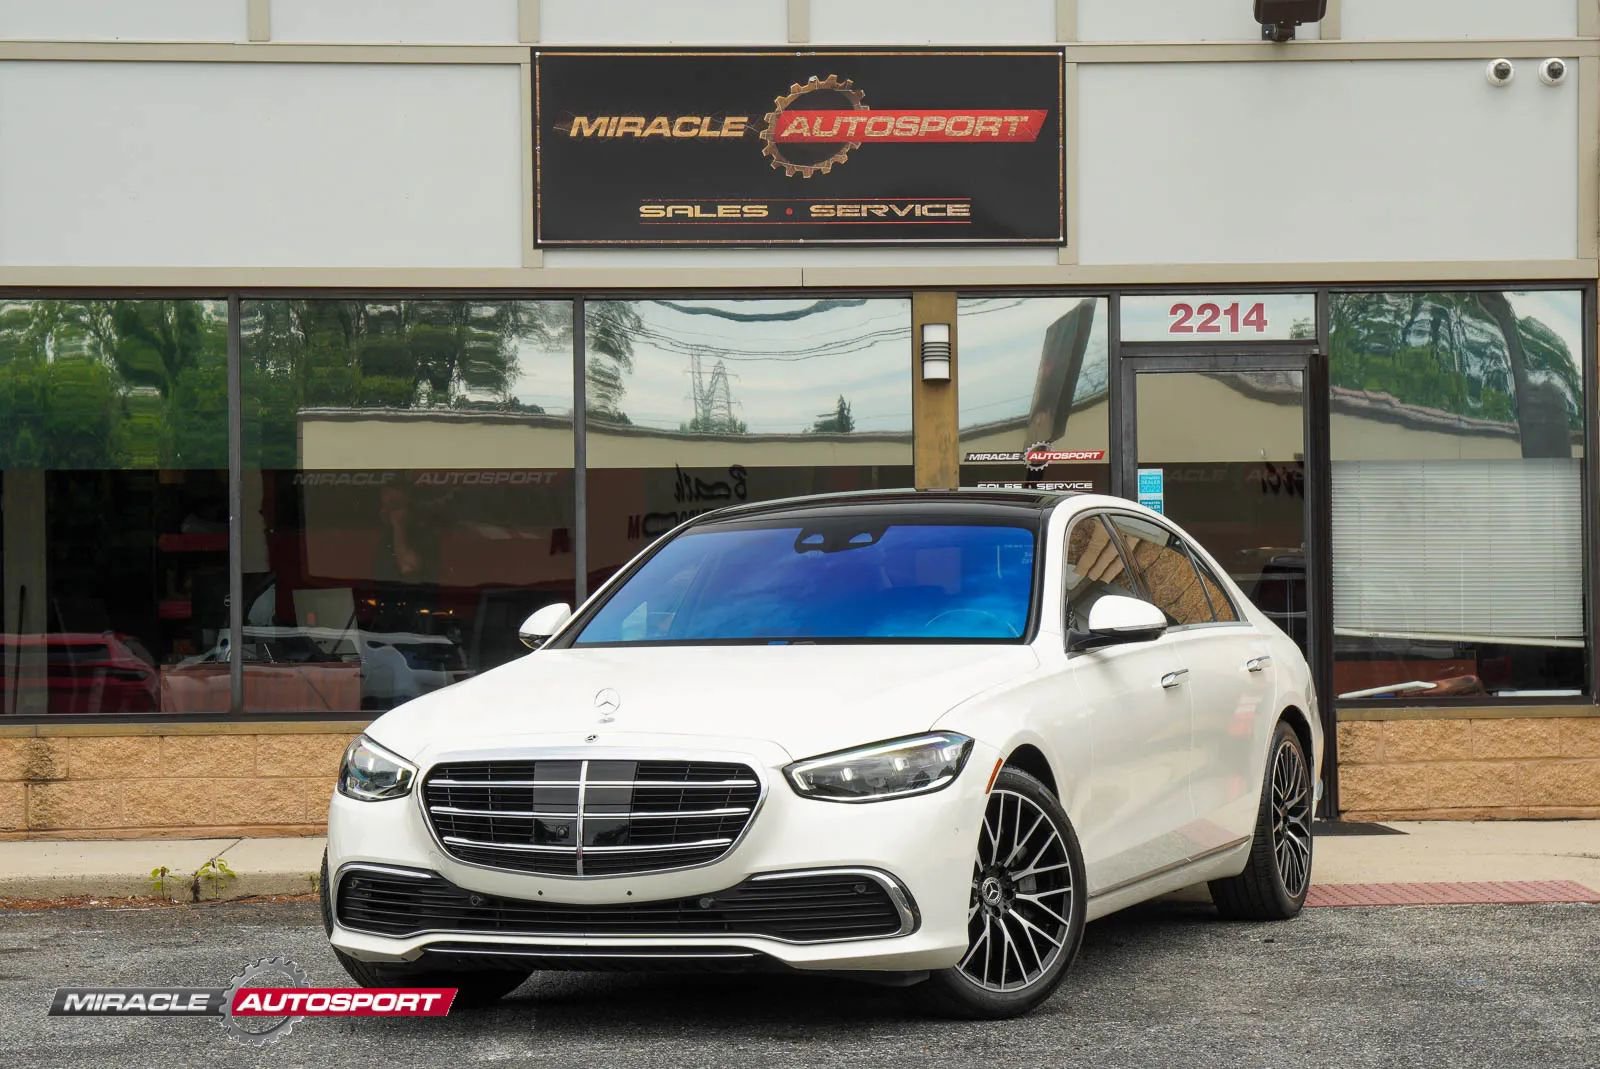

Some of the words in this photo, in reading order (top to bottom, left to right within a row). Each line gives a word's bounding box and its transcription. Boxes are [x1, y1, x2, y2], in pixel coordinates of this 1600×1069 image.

[569, 116, 749, 137] MIRACLE
[780, 115, 1030, 137] AUTOSPORT
[639, 204, 769, 218] SALES
[810, 203, 971, 218] SERVICE
[1168, 302, 1268, 334] 2214
[969, 453, 1020, 461] MIRACLE
[1029, 452, 1100, 460] AUTOSPORT
[415, 472, 558, 485] AUTOSPORT
[1036, 482, 1093, 490] SERVICE
